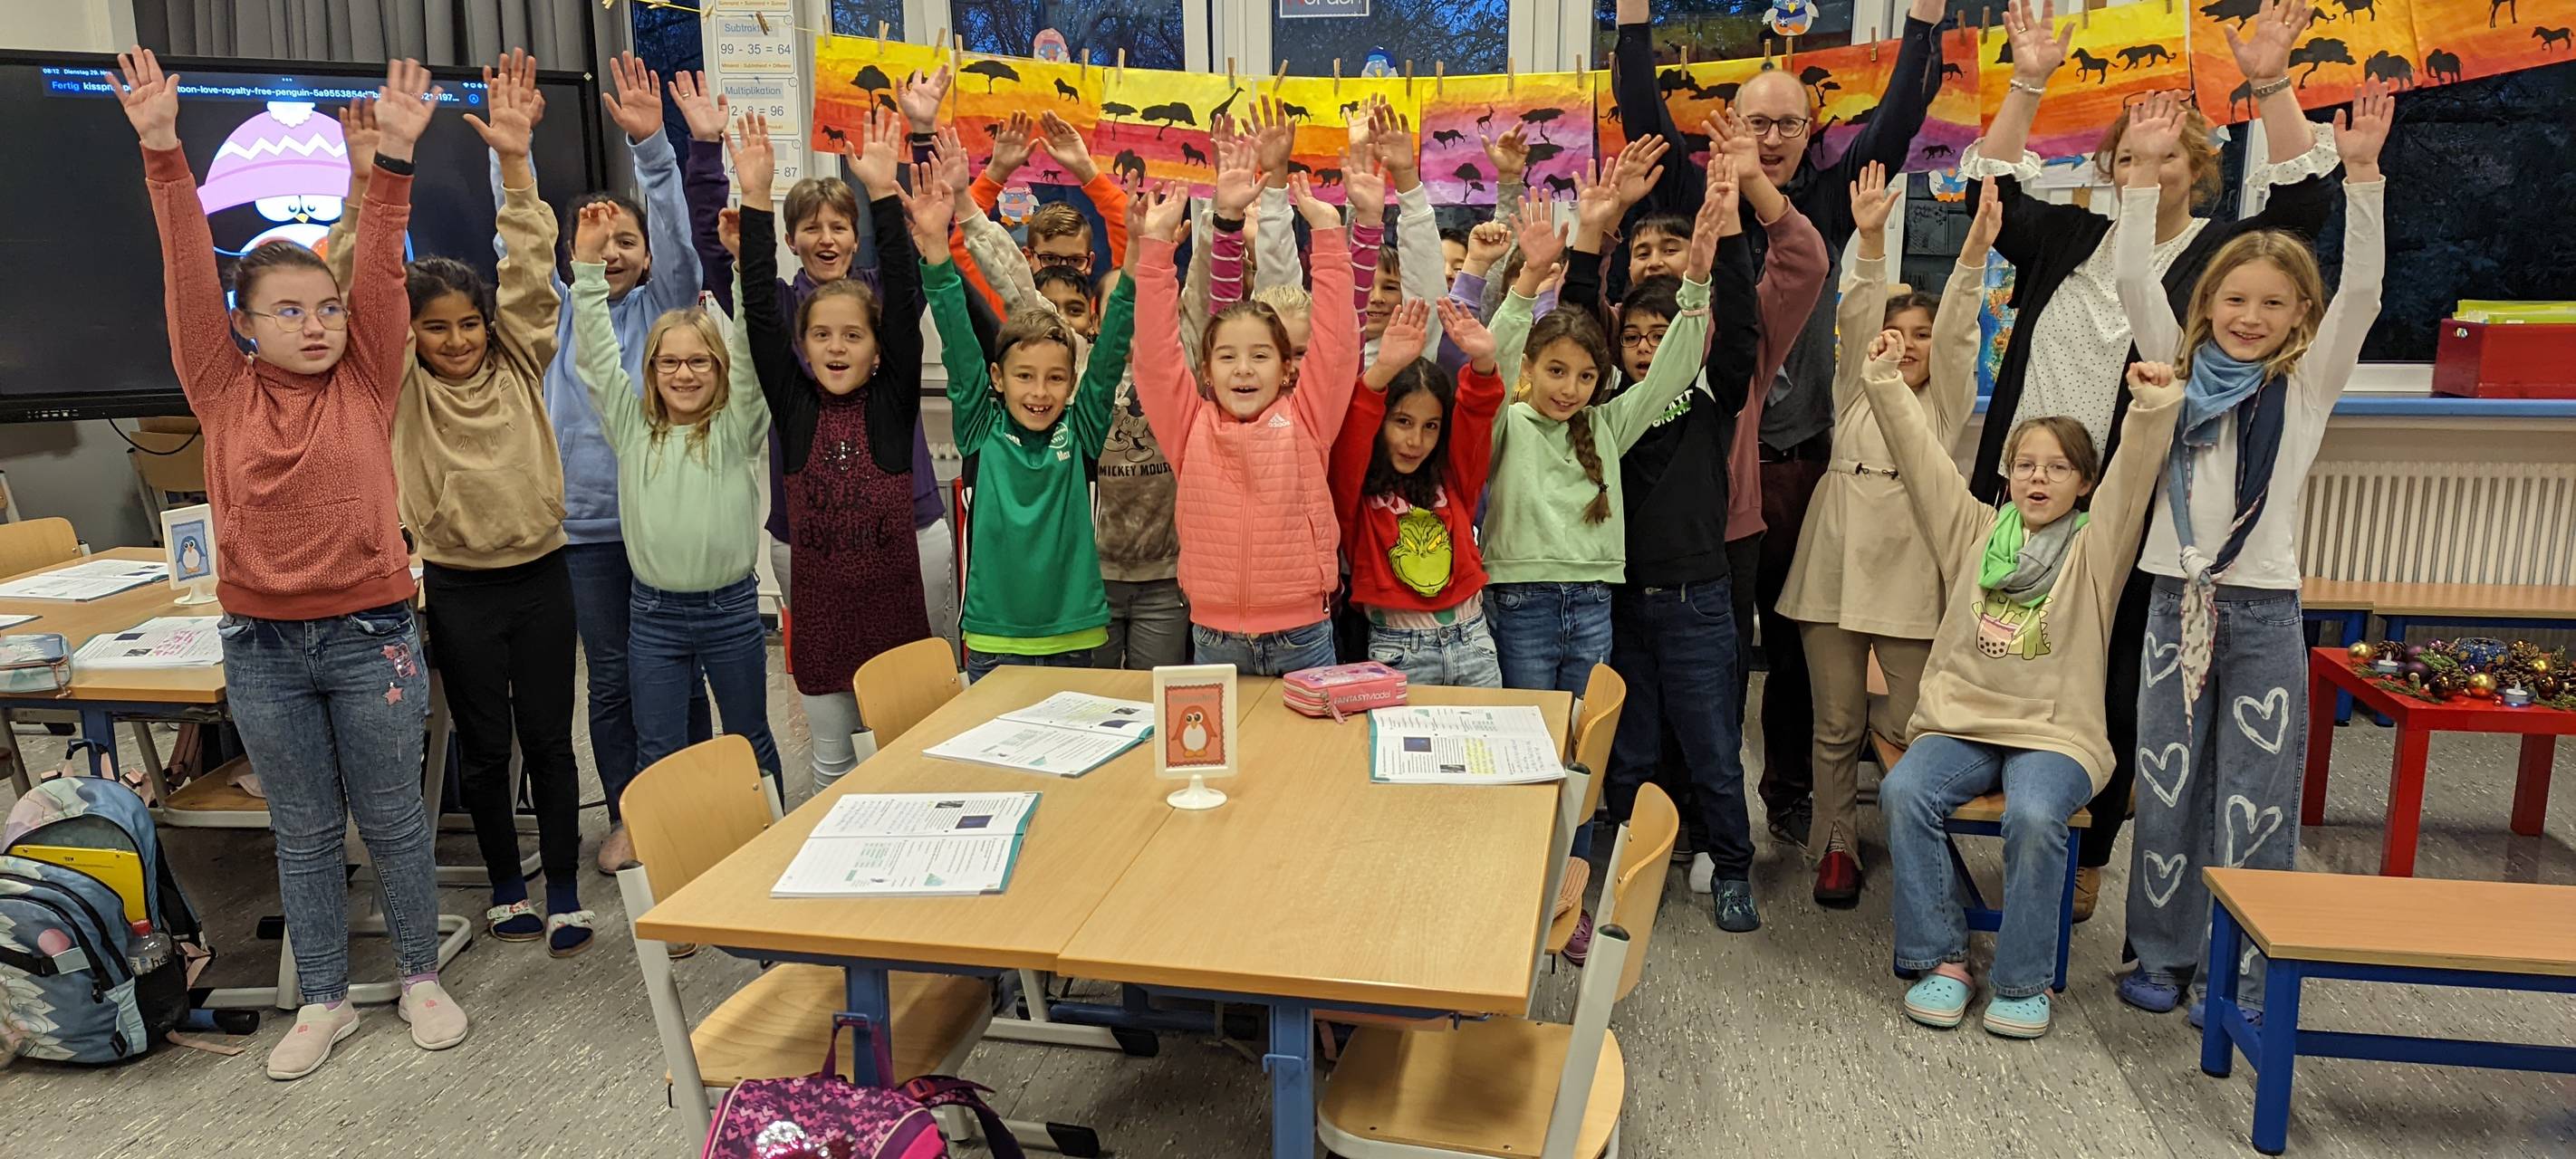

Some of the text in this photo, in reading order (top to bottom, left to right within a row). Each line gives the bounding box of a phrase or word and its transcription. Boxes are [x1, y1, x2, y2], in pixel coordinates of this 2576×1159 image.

[725, 23, 773, 33] Subtraktn
[721, 43, 735, 54] 99
[747, 43, 761, 54] 35
[777, 43, 791, 54] 64
[52, 81, 80, 91] Fertig
[725, 86, 782, 96] Multiplikation
[770, 106, 784, 116] 96
[784, 168, 797, 177] 87
[1099, 465, 1137, 476] MICKEY
